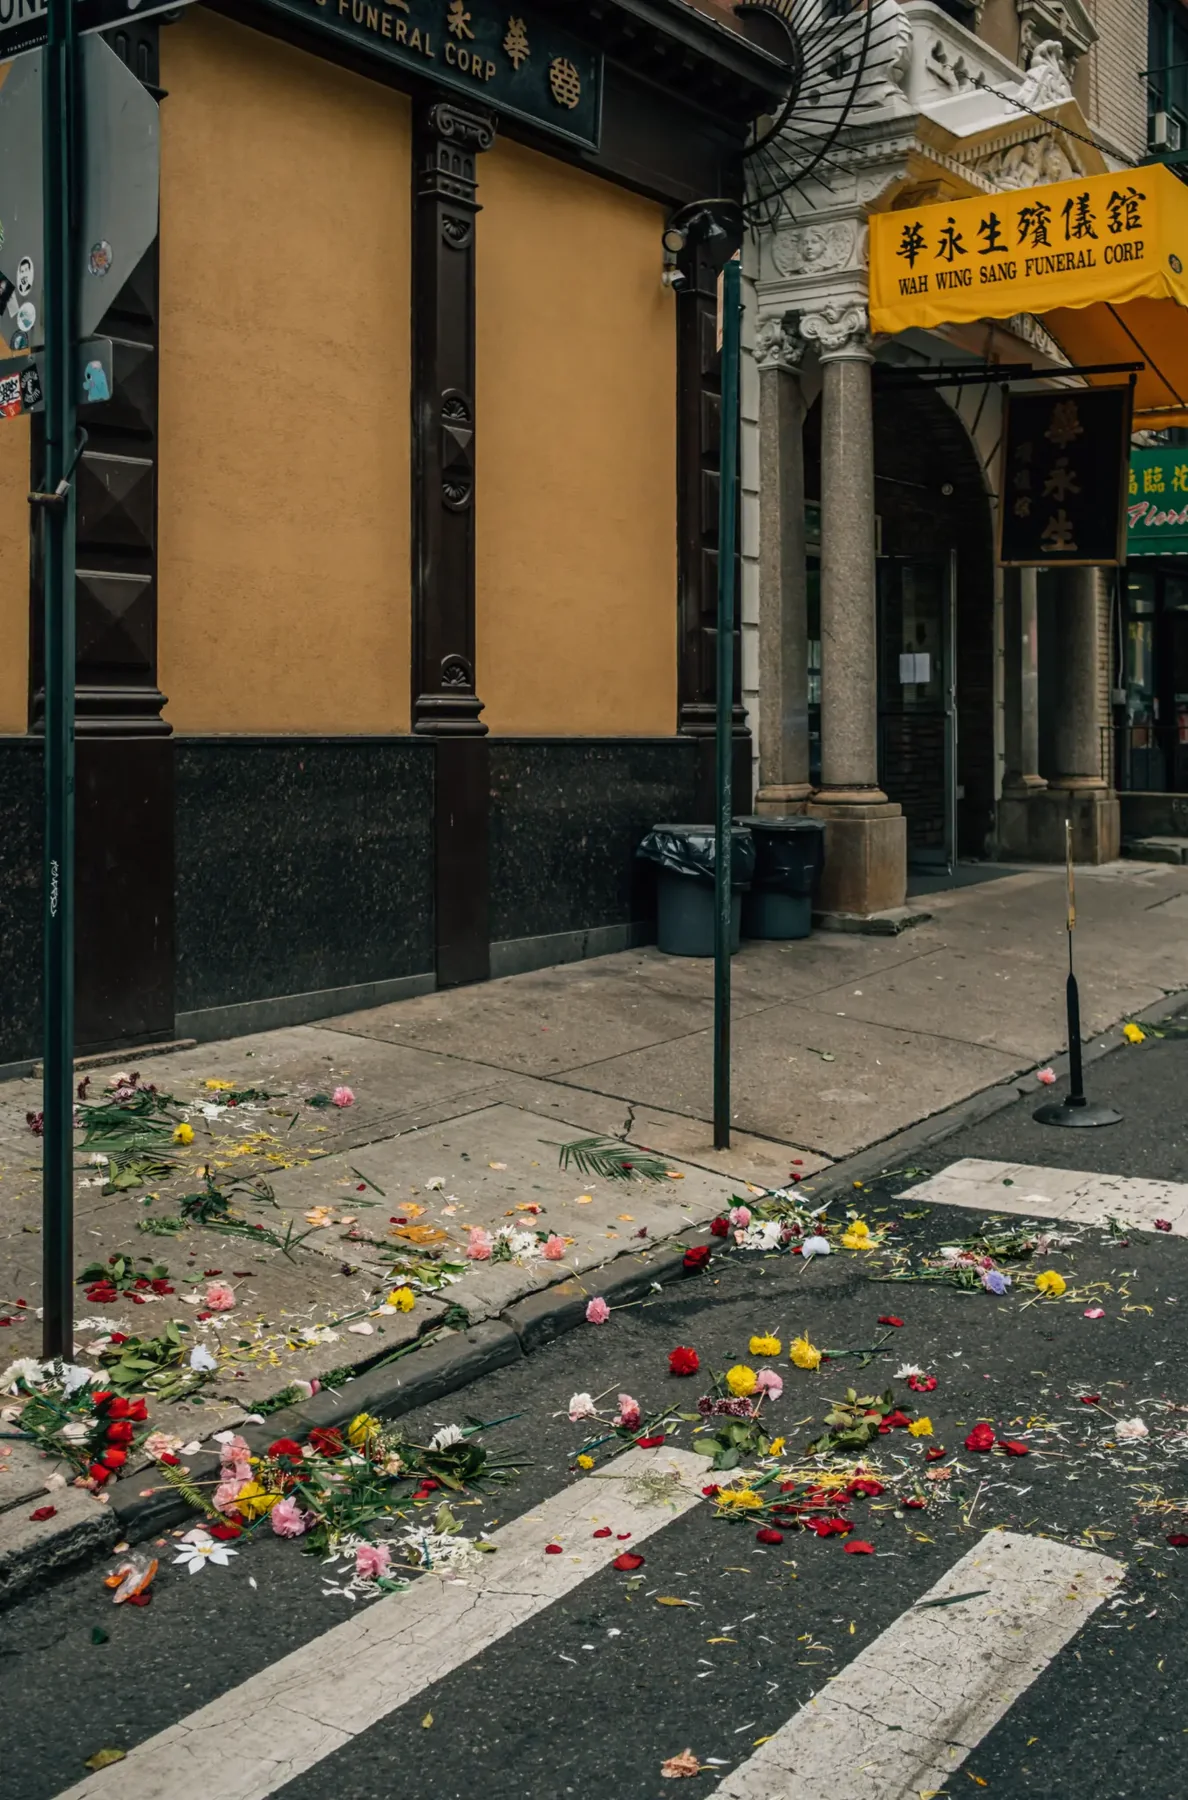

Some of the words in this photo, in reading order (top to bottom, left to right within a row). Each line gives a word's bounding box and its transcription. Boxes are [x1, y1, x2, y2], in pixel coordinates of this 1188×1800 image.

[338, 0, 435, 58] FUNERAL
[444, 42, 497, 81] CORP
[898, 274, 929, 296] WAH
[935, 268, 973, 290] WING
[979, 260, 1018, 284] SANG
[1024, 248, 1097, 277] FUNERAL
[1103, 240, 1145, 265] CORP.
